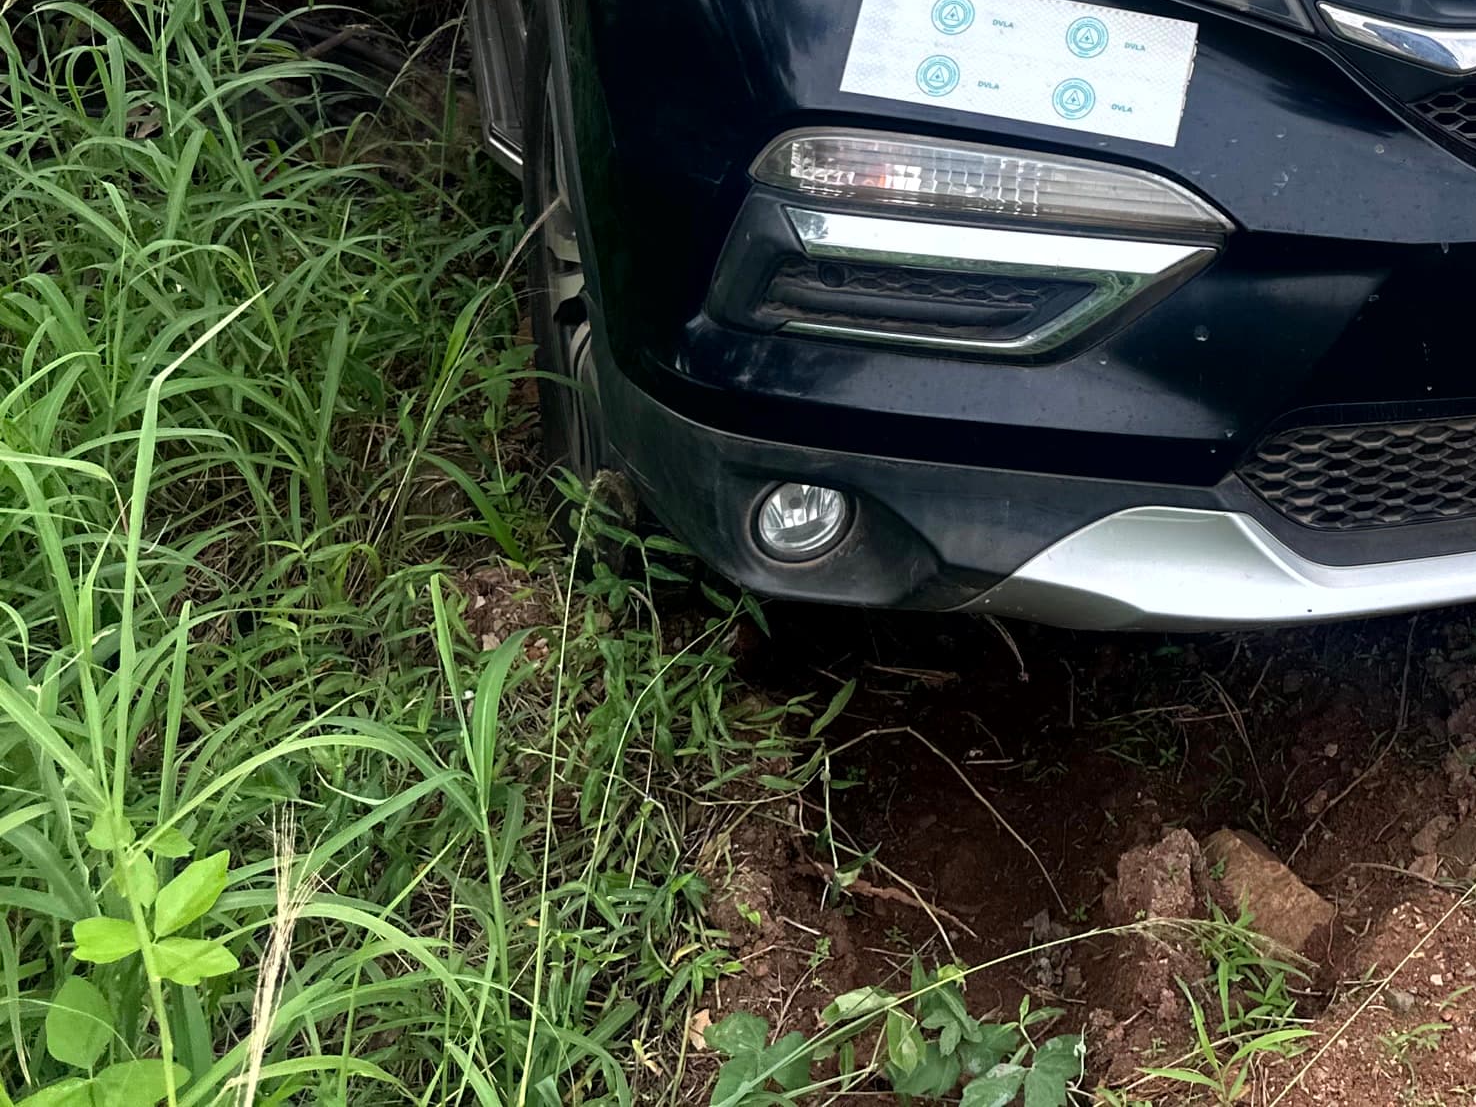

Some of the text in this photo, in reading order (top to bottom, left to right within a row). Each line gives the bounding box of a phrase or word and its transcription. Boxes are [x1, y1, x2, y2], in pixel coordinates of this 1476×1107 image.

[992, 18, 1014, 29] DVLA
[1124, 41, 1146, 52] DVLA
[977, 80, 1000, 91] DVLA
[1111, 102, 1133, 113] DVLA
